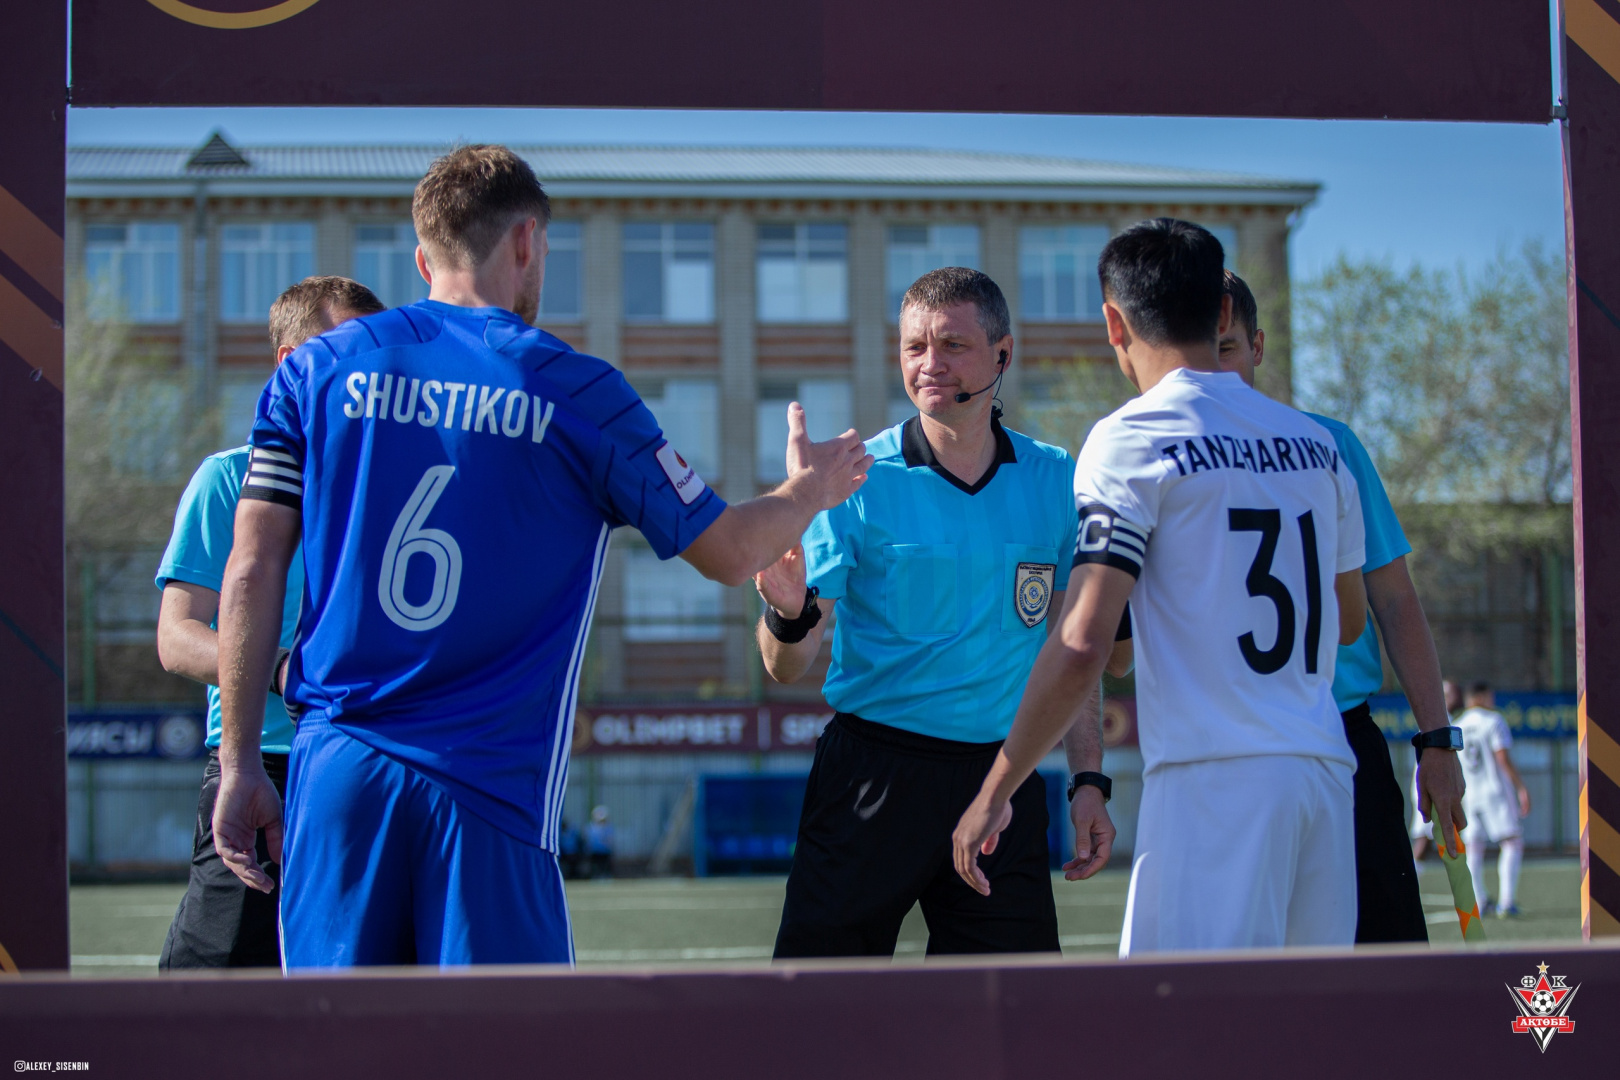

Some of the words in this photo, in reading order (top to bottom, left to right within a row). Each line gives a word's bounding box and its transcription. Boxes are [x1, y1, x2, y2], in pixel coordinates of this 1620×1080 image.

[343, 371, 555, 444] SHUSTIKOV
[377, 465, 463, 632] 6
[1079, 513, 1111, 552] C
[1227, 507, 1322, 675] 31
[592, 714, 747, 746] OLIMPBET
